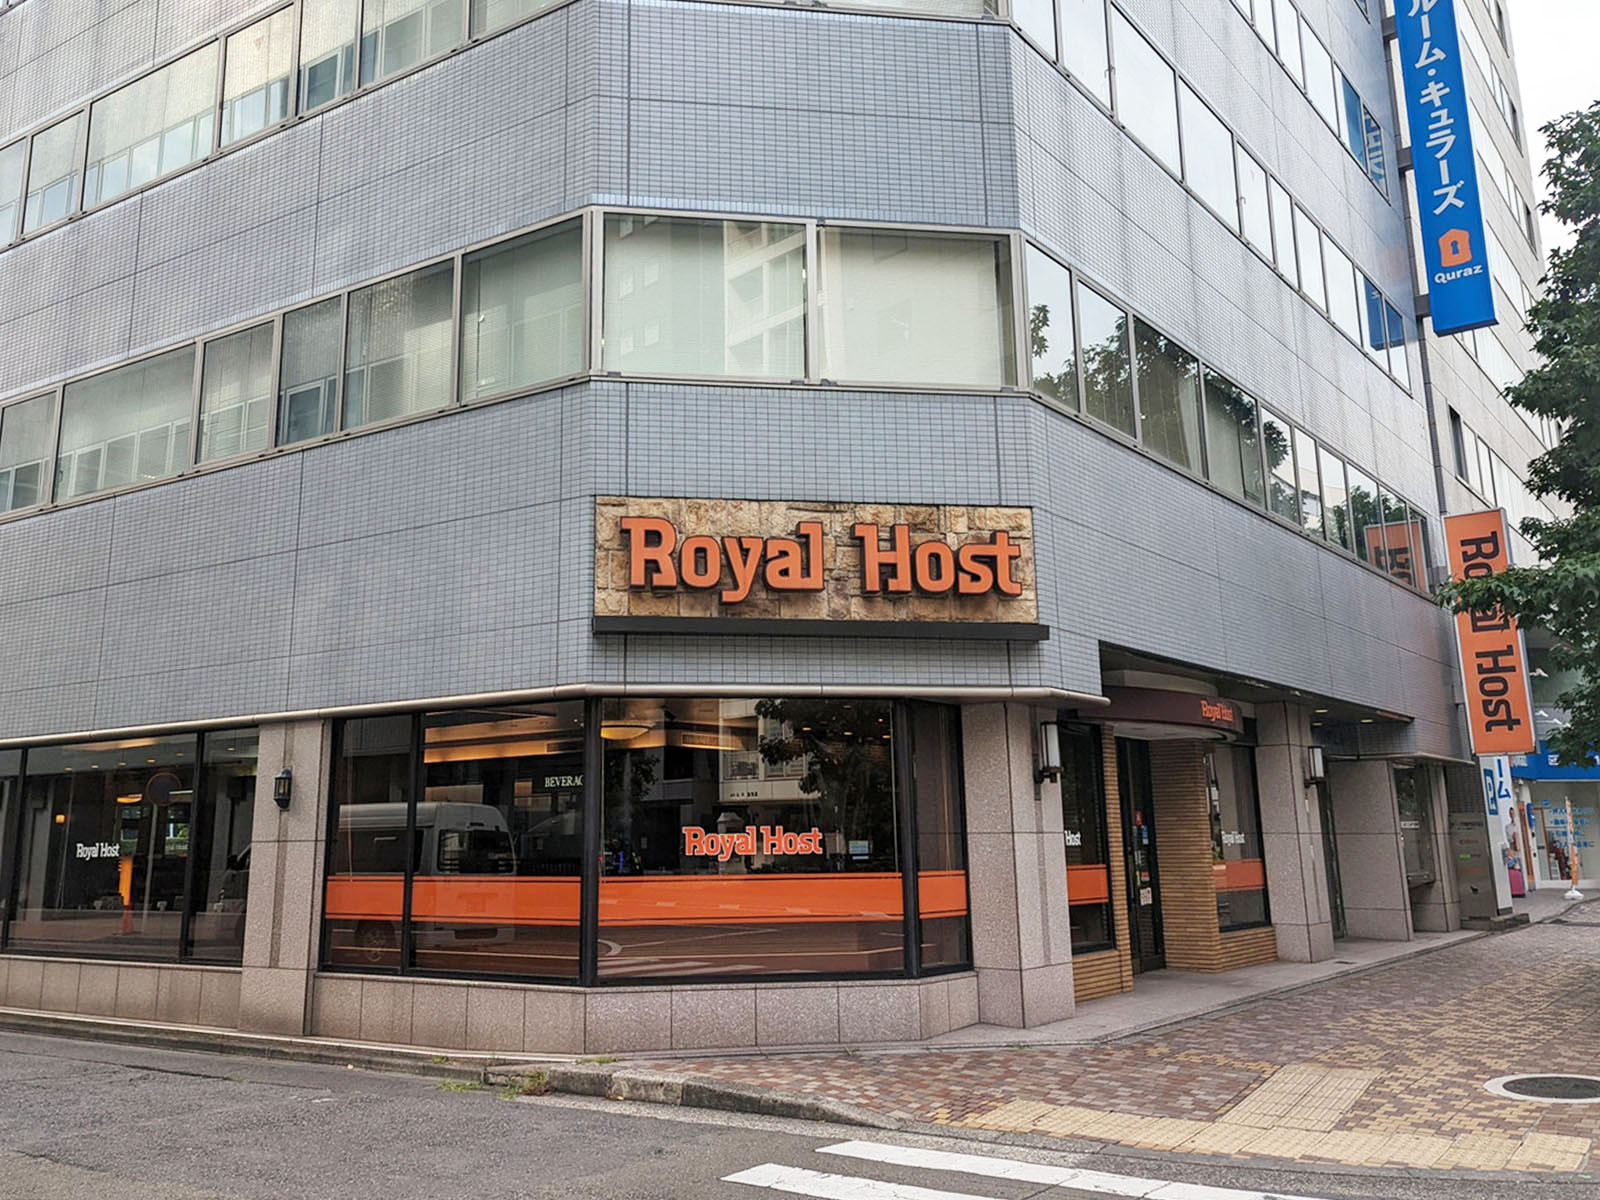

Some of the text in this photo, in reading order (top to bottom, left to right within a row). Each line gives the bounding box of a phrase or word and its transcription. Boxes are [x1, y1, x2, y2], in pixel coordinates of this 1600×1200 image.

[1434, 264, 1483, 284] Quraz
[620, 516, 1022, 603] Royal Host
[1460, 531, 1522, 733] Roal Host
[76, 842, 120, 861] Royal Host
[682, 825, 823, 862] Royal Host
[1065, 830, 1081, 846] Host
